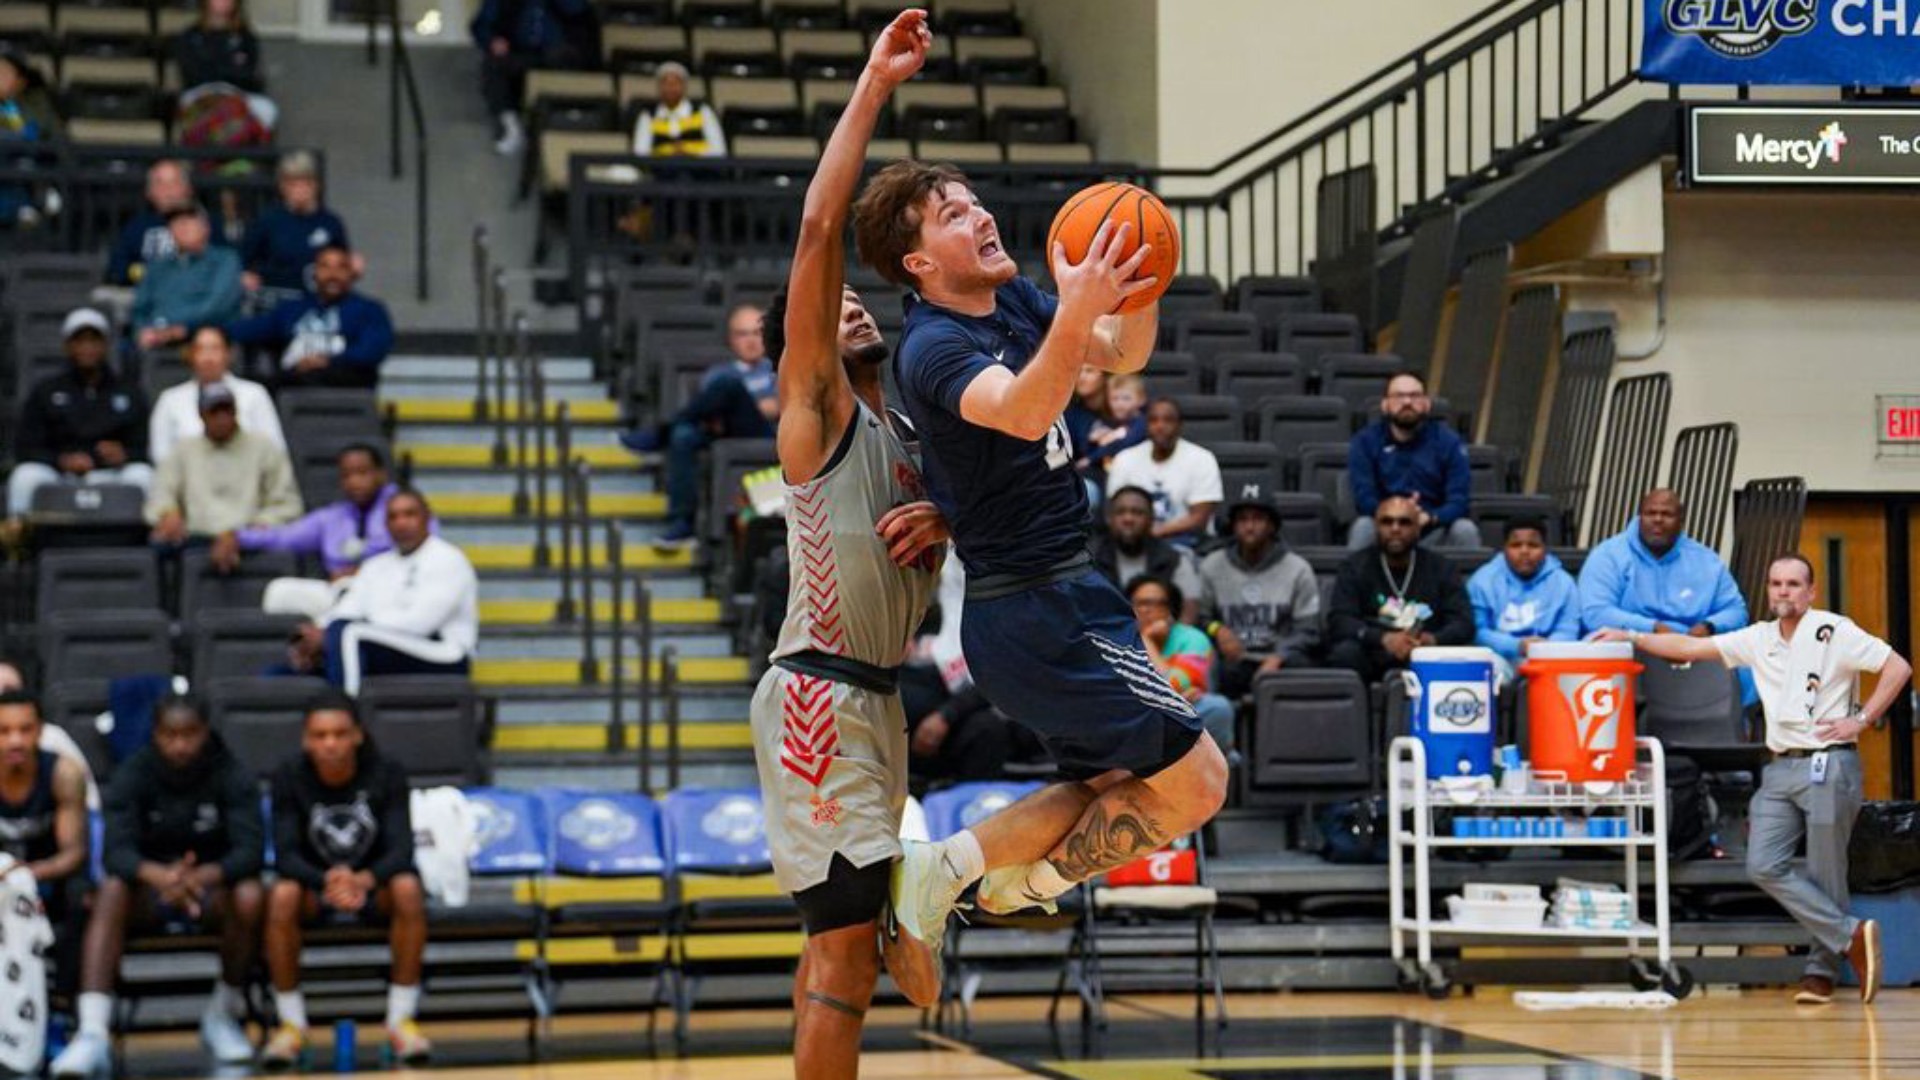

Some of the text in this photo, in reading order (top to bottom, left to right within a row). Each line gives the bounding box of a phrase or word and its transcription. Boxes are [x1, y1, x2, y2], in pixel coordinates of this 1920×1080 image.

[1667, 0, 1815, 31] GLVC
[1831, 0, 1920, 36] CH
[1735, 133, 1823, 169] Mercy
[1878, 134, 1911, 154] The
[1581, 678, 1614, 716] G
